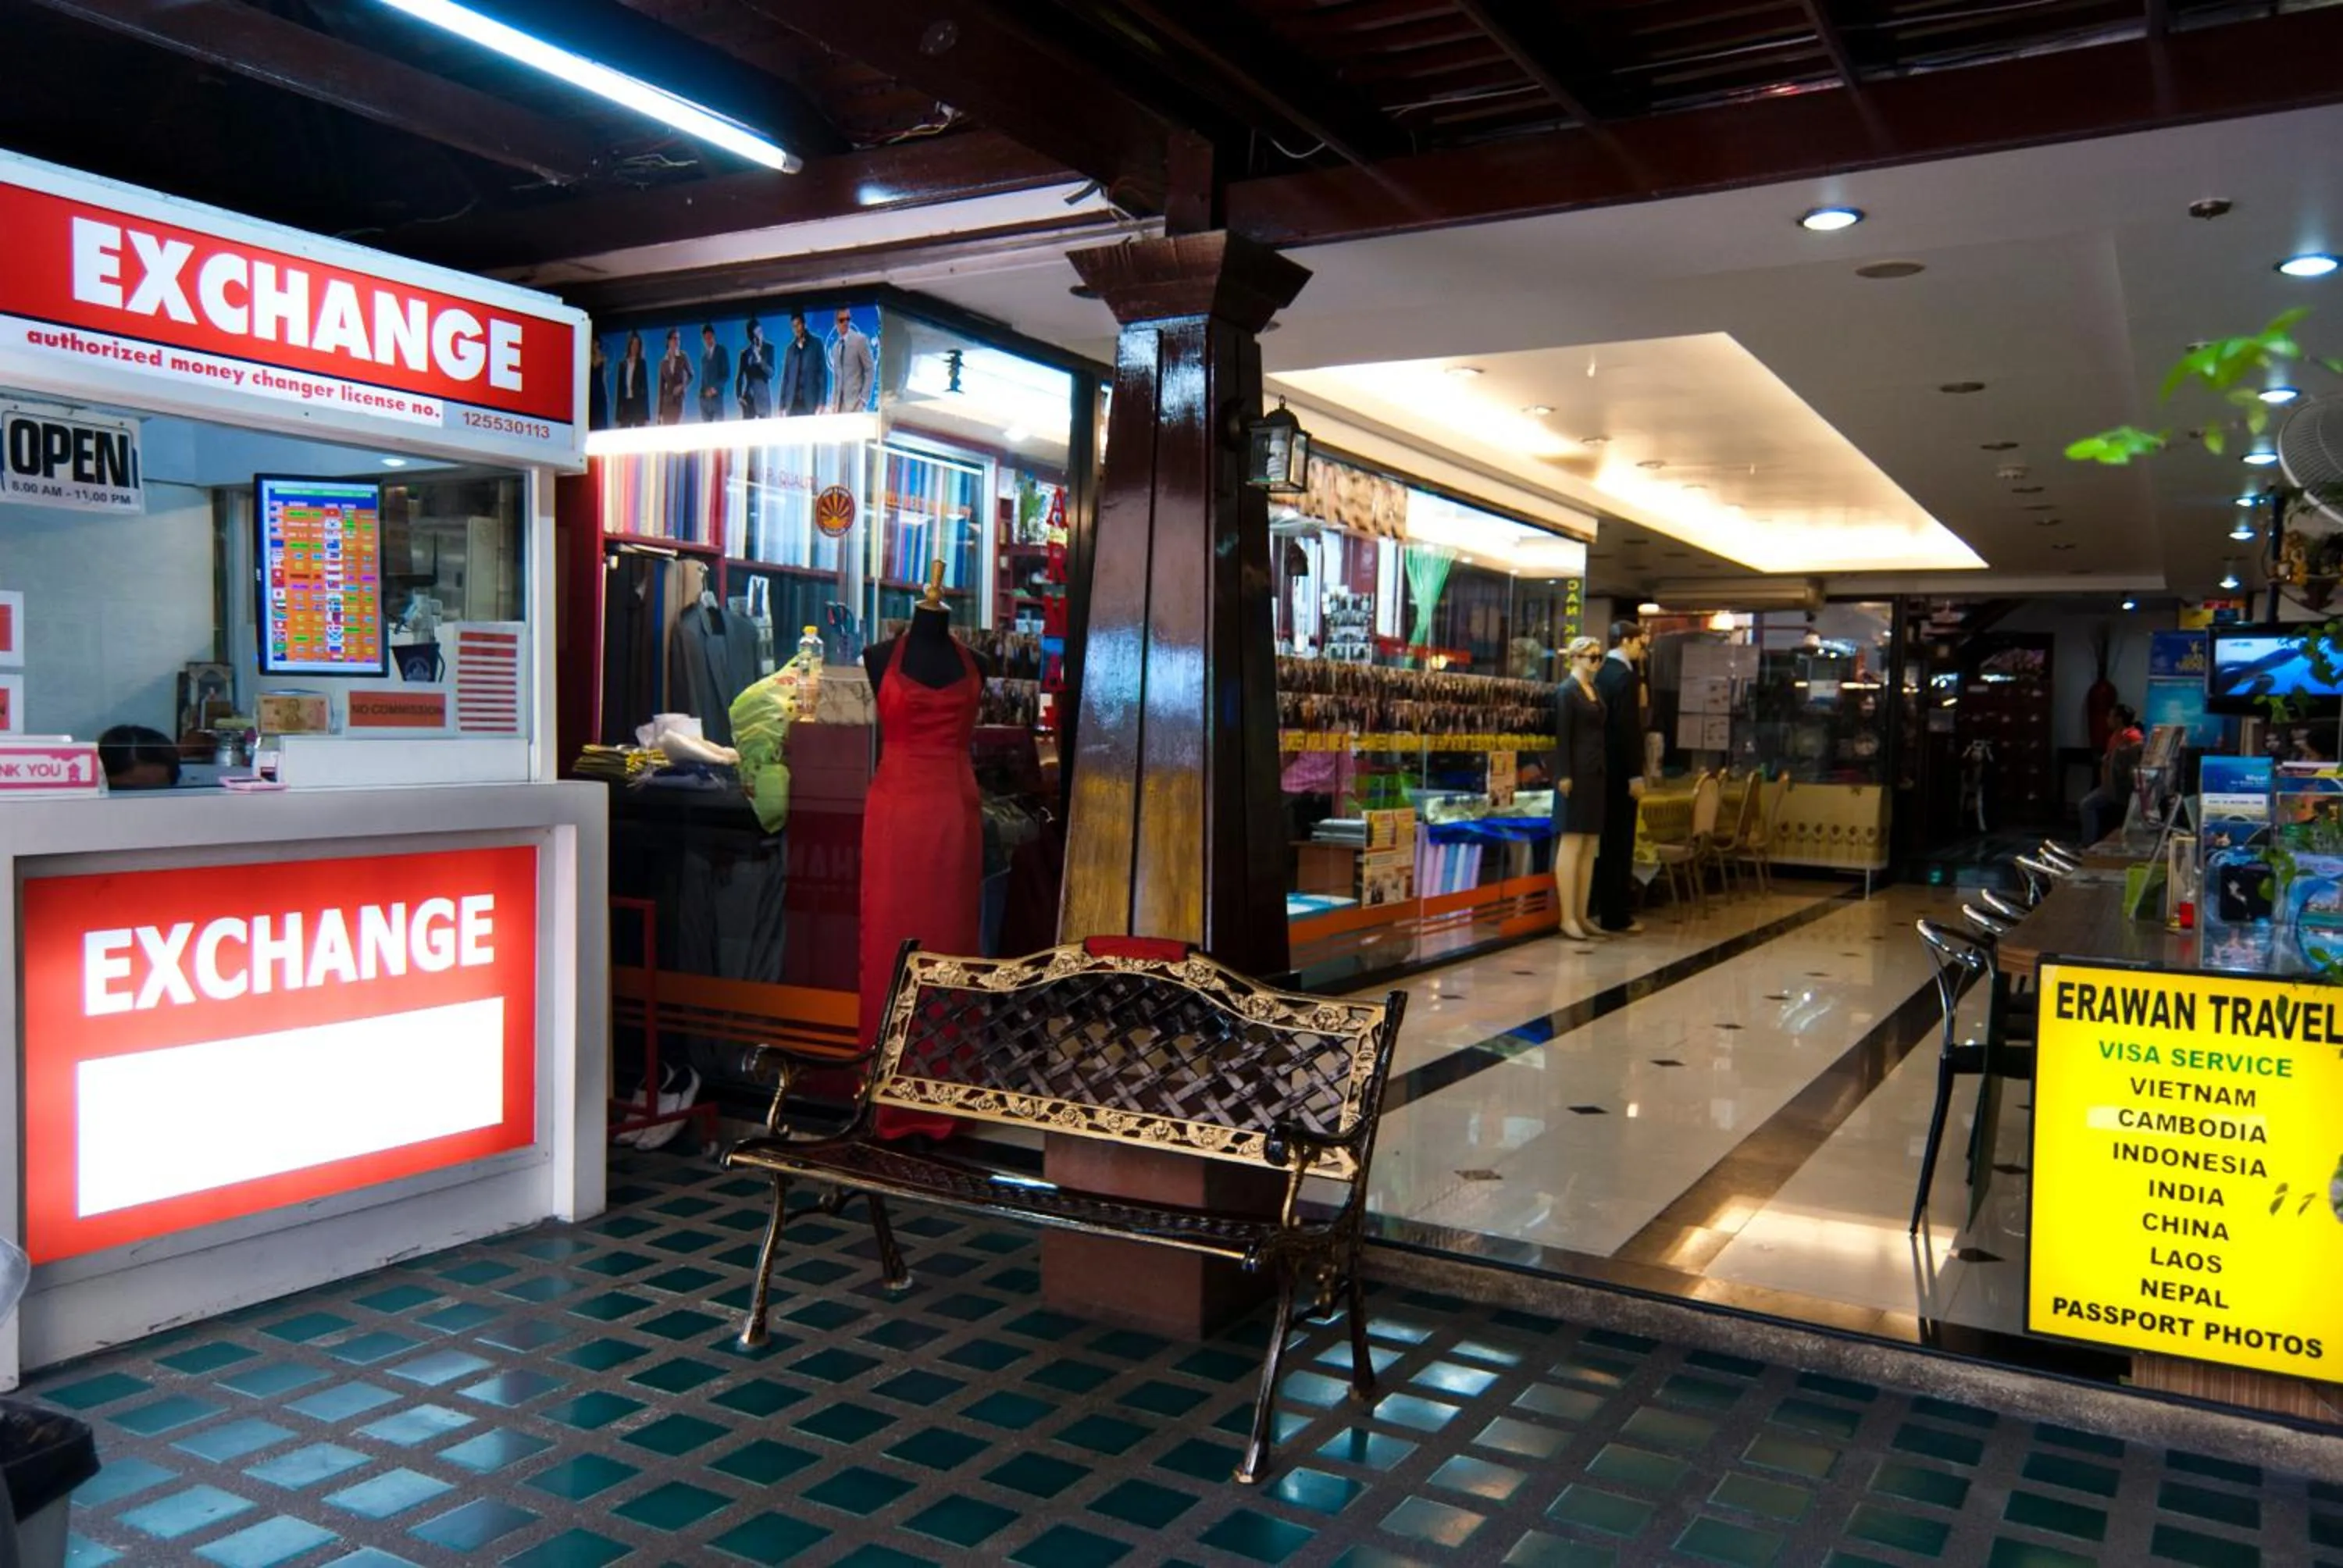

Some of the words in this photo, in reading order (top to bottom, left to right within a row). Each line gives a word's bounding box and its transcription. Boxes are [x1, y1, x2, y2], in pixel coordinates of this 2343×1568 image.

[72, 216, 523, 392] EXCHANGE
[27, 329, 162, 367] authorized
[170, 355, 245, 386] money
[251, 369, 335, 399] changer
[341, 384, 405, 412] license
[412, 402, 440, 419] no.
[462, 412, 551, 439] 125530113
[9, 419, 130, 488] OPEN
[41, 485, 62, 497] AM
[111, 494, 132, 505] PM
[351, 704, 369, 715] NO
[27, 762, 62, 777] YOU
[84, 893, 495, 1017] EXCHANGE
[2056, 982, 2196, 1032] ERAWAN
[2208, 993, 2343, 1046] TRAVEL
[2099, 1039, 2161, 1064] VISA
[2171, 1047, 2293, 1078] SERVICE
[2130, 1076, 2257, 1108] VIETNAM
[2117, 1108, 2267, 1144] CAMBODIA
[2113, 1142, 2268, 1178] INDONESIA
[2149, 1179, 2225, 1207] INDIA
[2142, 1213, 2230, 1242] CHINA
[2150, 1246, 2223, 1274] LAOS
[2140, 1278, 2230, 1310] NEPAL
[2052, 1296, 2194, 1338] PASSPORT
[2204, 1322, 2323, 1360] PHOTOS
